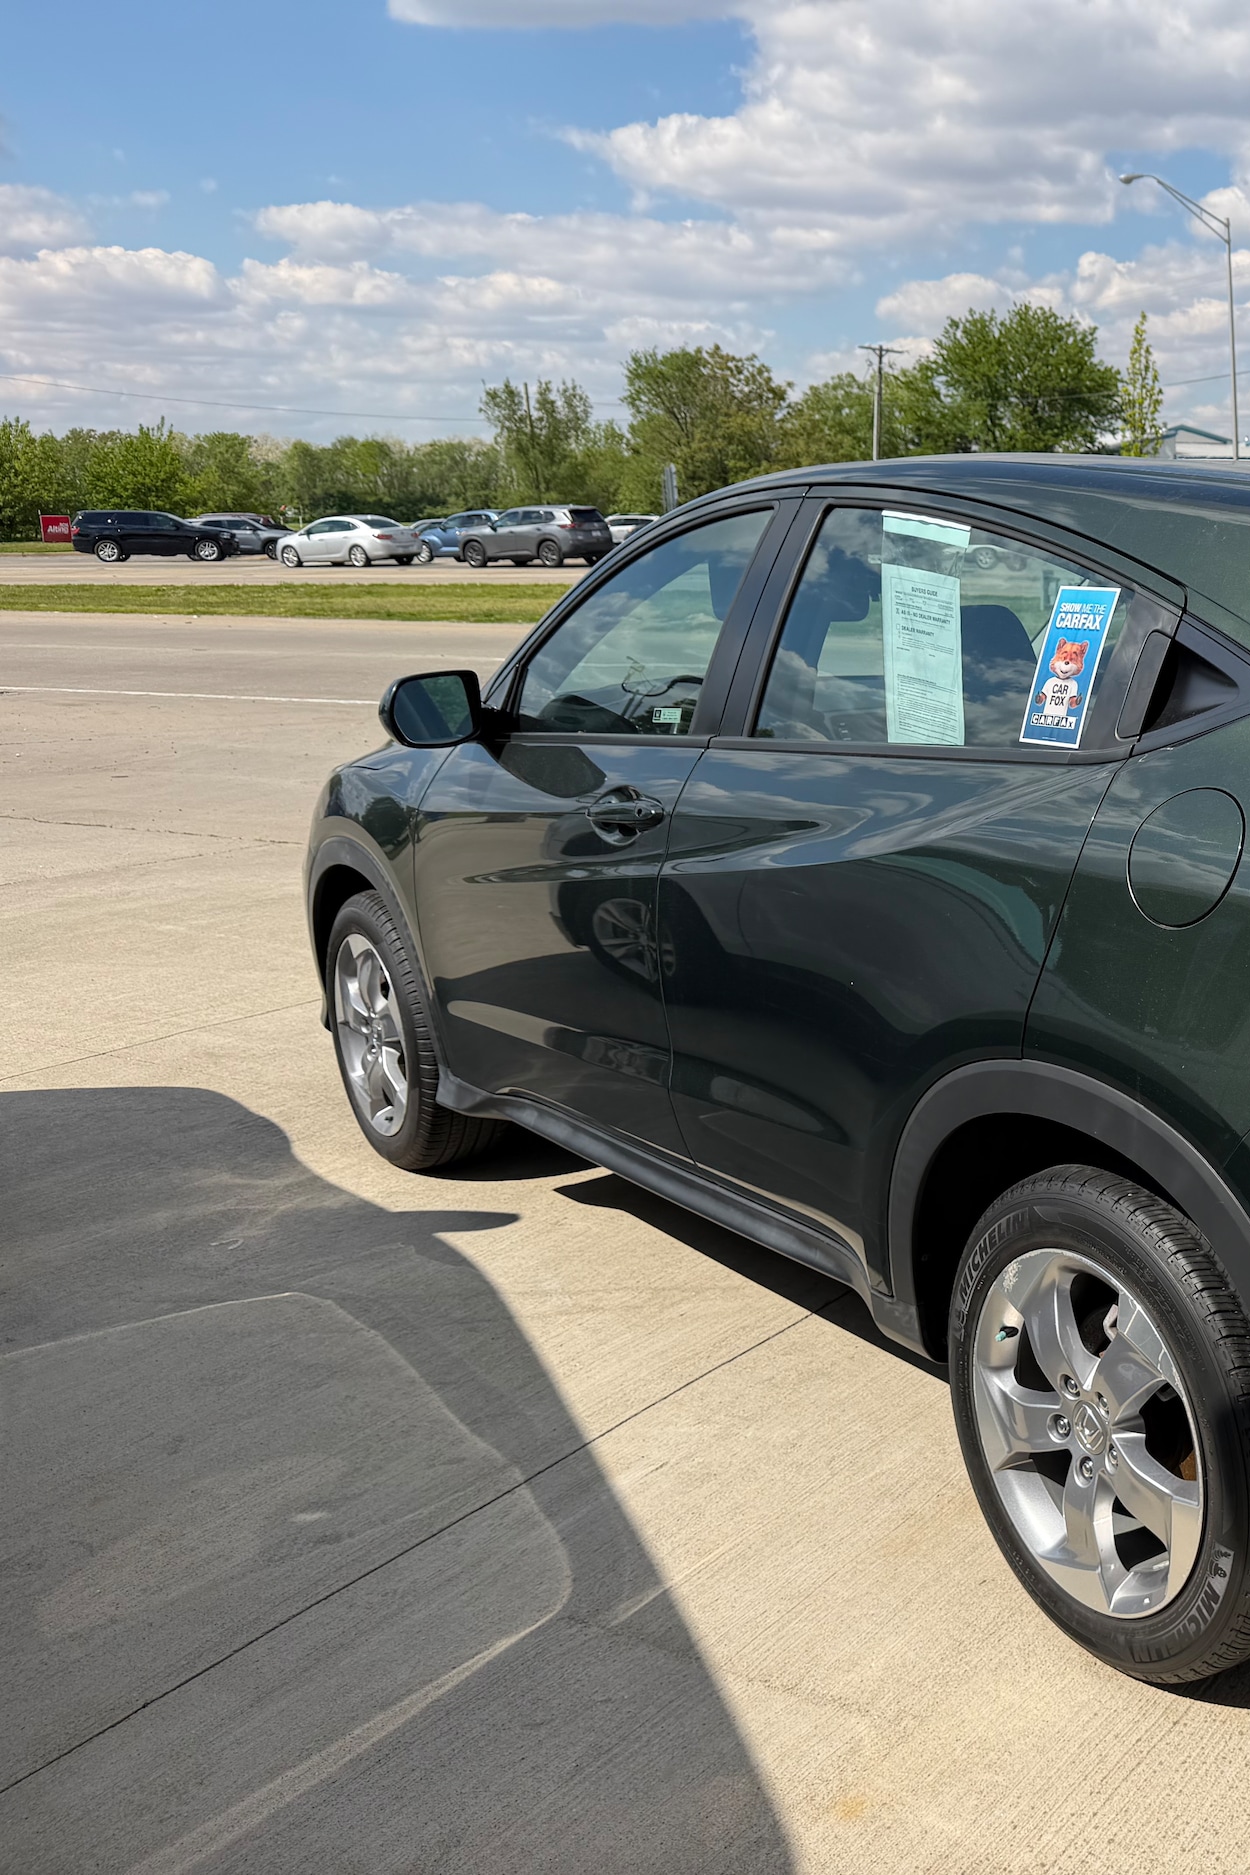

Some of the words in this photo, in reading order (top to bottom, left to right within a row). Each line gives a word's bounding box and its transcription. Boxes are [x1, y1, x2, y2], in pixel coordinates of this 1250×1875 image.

[1059, 602, 1081, 613] SHOW
[1081, 603, 1094, 613] ME
[1094, 604, 1107, 615] THE
[1056, 613, 1104, 630] CARFAX
[1052, 683, 1069, 695] CAR
[1049, 695, 1066, 707] FOX
[1031, 713, 1074, 728] CARFAX
[958, 1206, 1032, 1308] MICHELIN
